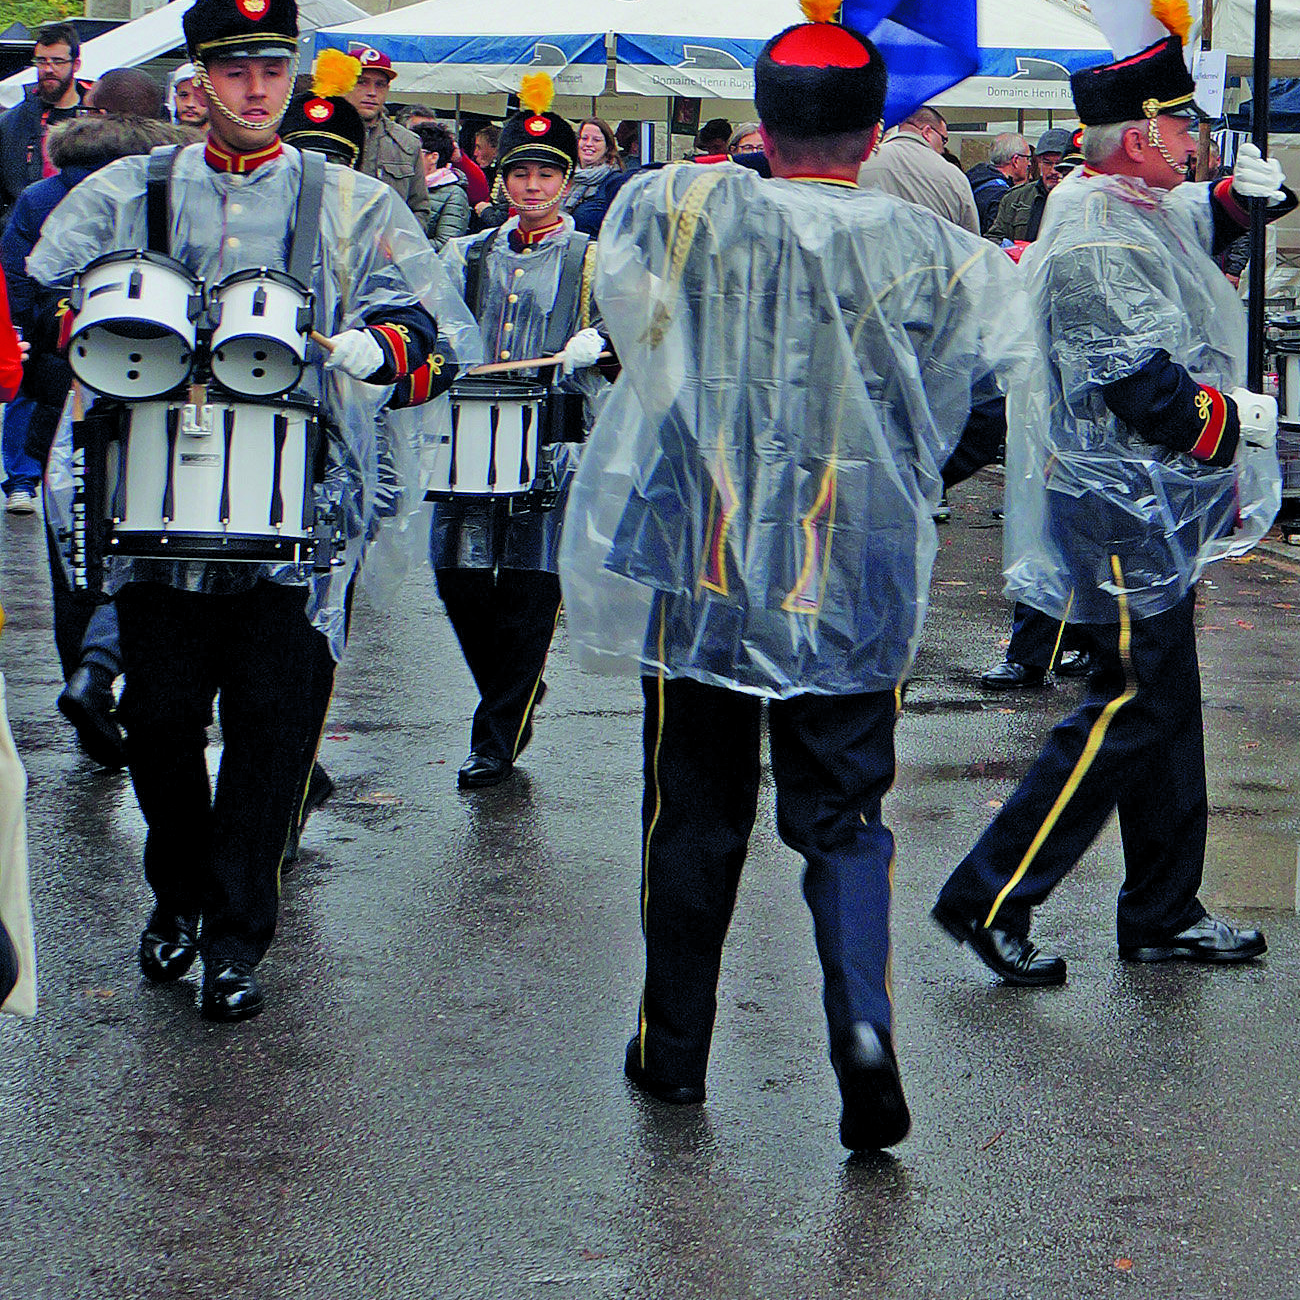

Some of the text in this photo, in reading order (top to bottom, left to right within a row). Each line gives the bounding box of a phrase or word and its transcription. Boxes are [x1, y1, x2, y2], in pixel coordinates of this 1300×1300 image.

[652, 75, 696, 86] Domaine
[699, 77, 726, 87] Henri
[987, 86, 1029, 97] Domaine
[1032, 88, 1058, 98] Henri
